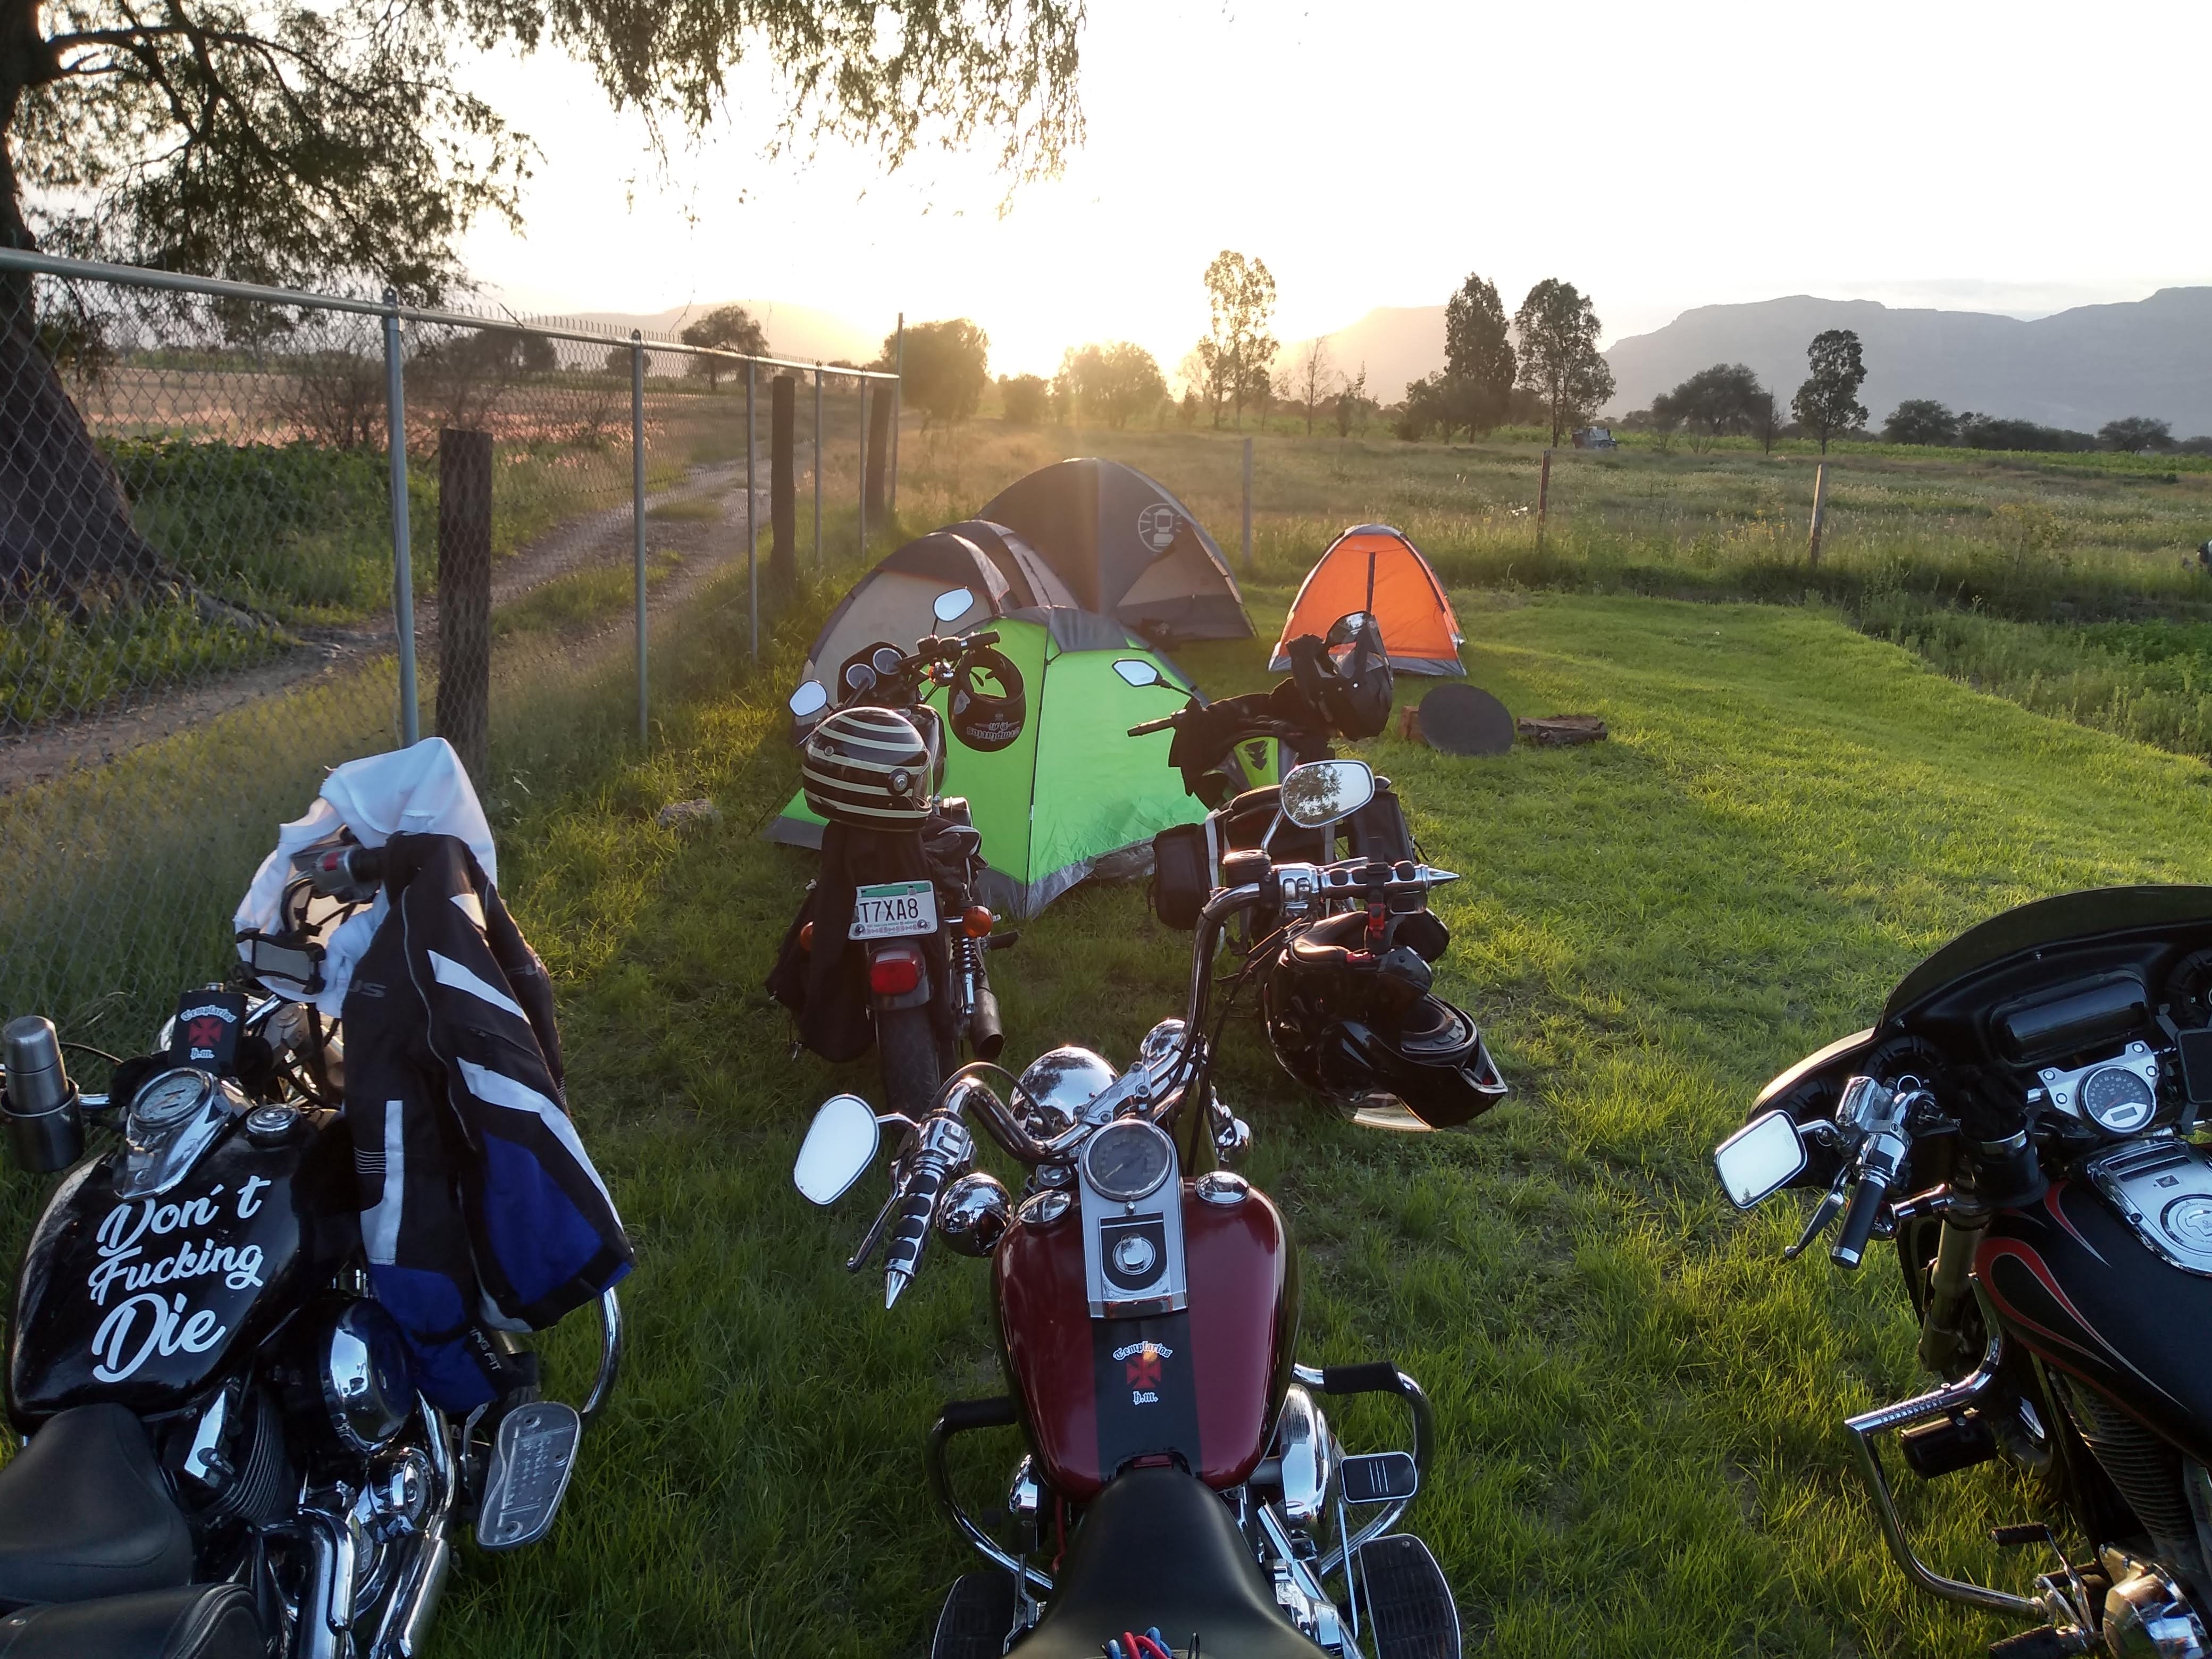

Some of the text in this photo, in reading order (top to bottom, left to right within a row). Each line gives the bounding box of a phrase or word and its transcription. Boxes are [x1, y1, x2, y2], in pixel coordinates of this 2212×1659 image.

[859, 898, 919, 923] T7XA8
[180, 1004, 238, 1023] Templarios
[88, 1238, 264, 1306] Fucking
[91, 1292, 227, 1383] Die
[1113, 1340, 1173, 1361] Templarios
